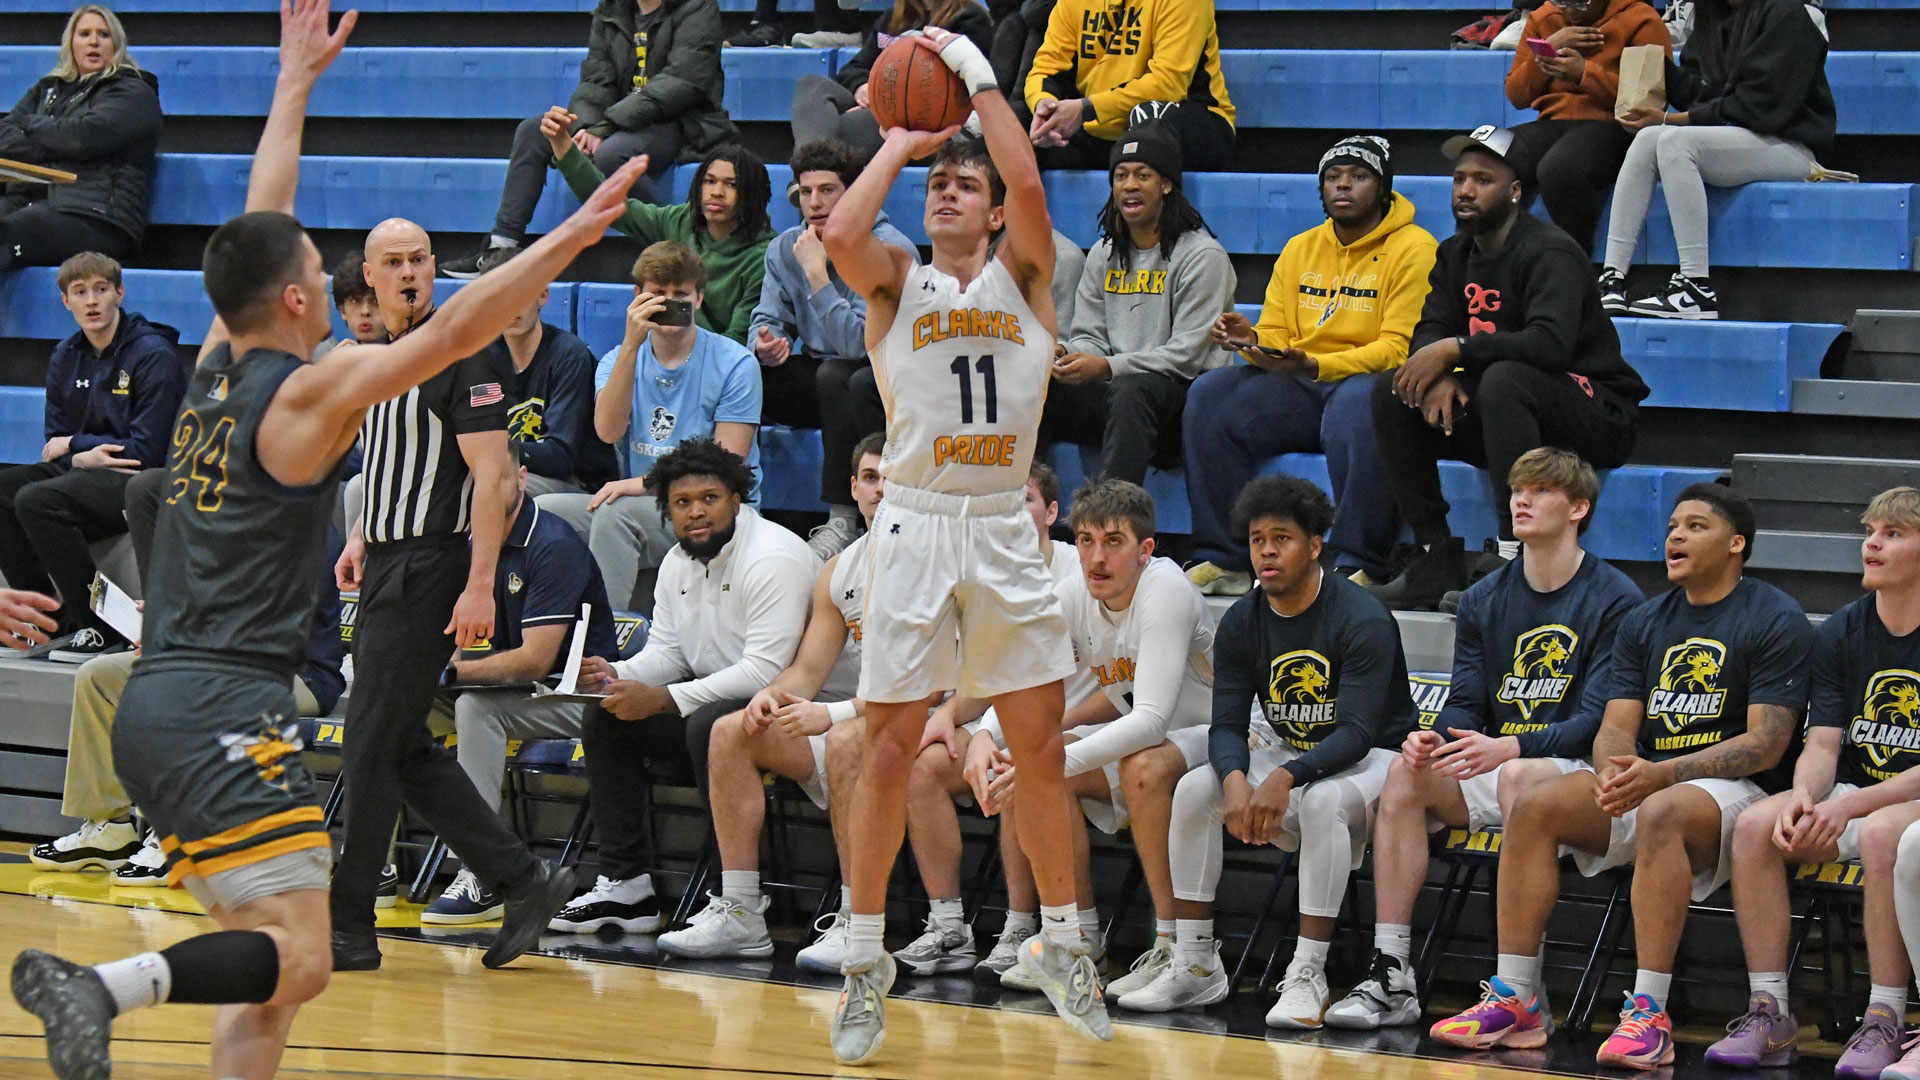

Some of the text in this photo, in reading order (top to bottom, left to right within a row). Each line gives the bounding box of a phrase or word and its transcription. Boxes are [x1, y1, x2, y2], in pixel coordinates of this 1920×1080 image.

[912, 307, 1025, 352] CLARKE
[950, 354, 998, 424] 11
[933, 434, 1017, 467] PRIDE
[1267, 697, 1335, 723] CLARKE
[1648, 690, 1722, 715] CLARKE
[1655, 730, 1722, 750] BASKETBALL
[1794, 863, 1868, 886] PRI
